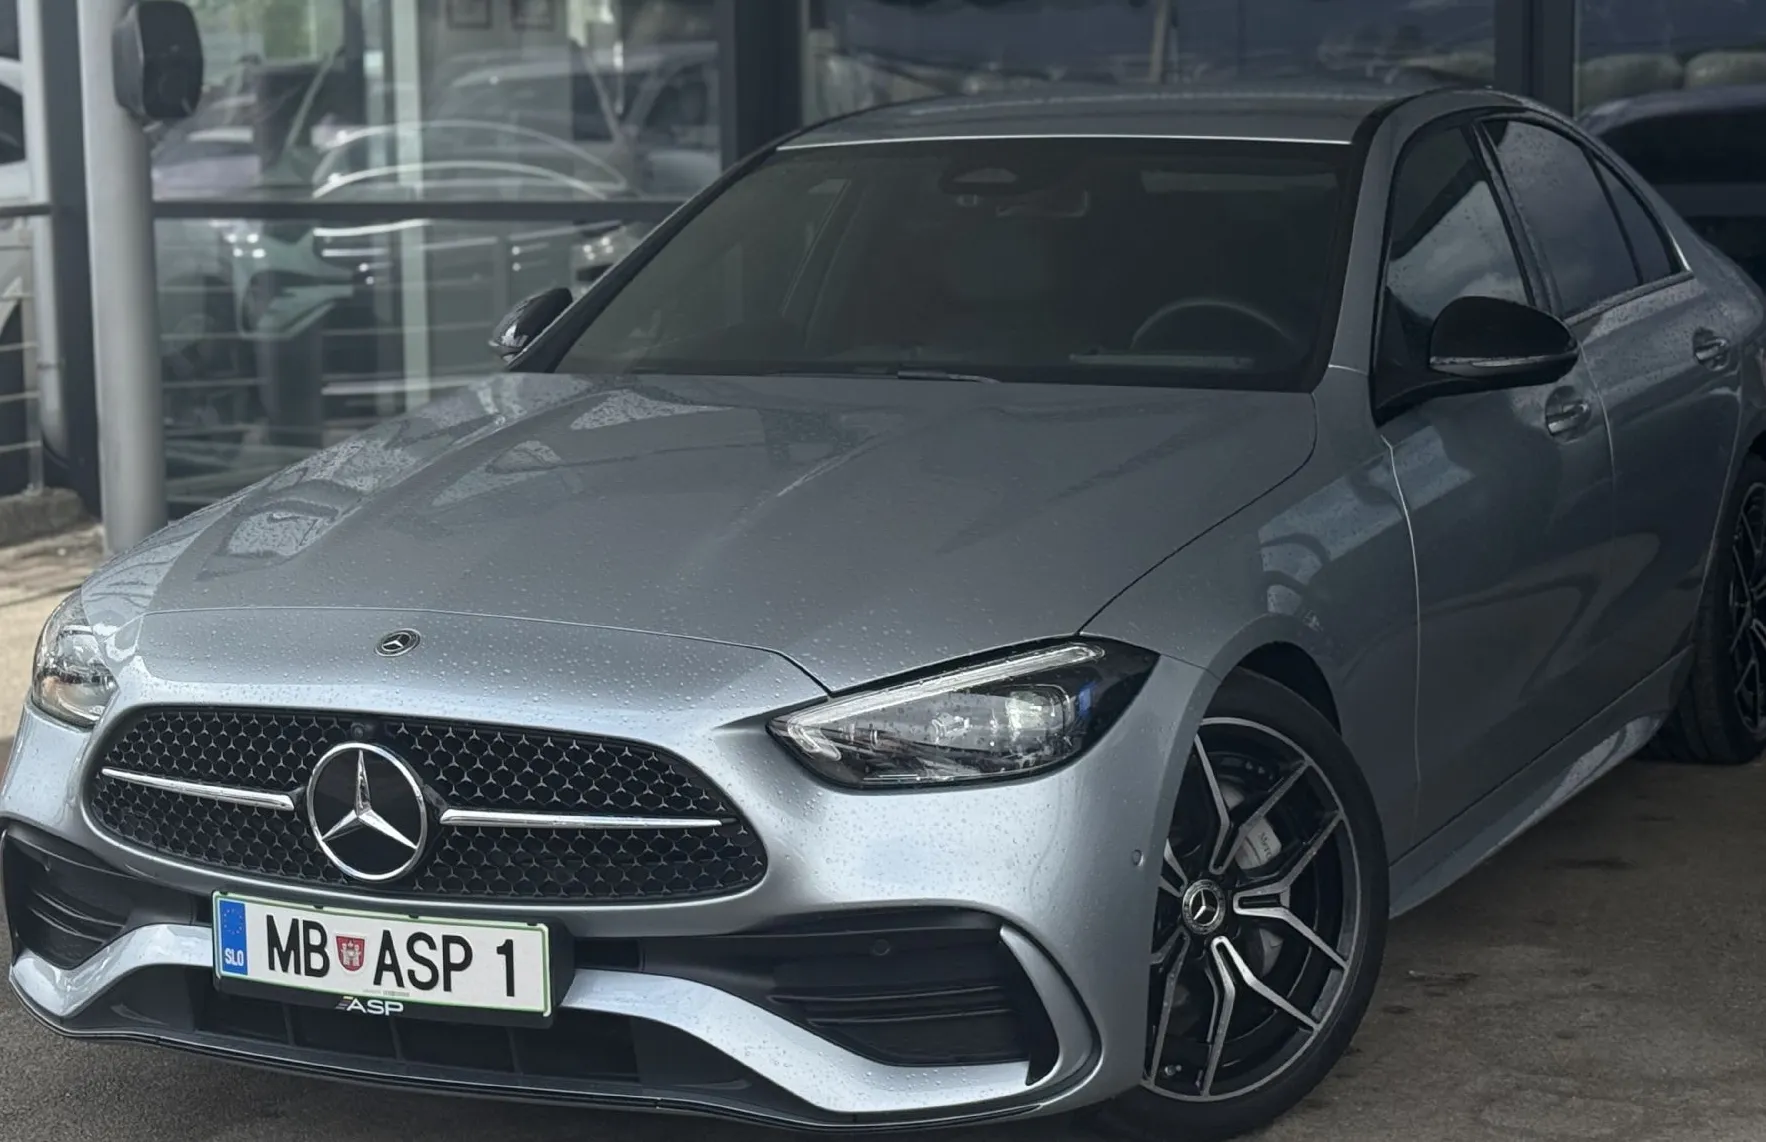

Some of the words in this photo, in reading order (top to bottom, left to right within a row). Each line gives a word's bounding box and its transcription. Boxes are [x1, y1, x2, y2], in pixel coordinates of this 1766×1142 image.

[225, 948, 244, 967] SLO
[266, 914, 330, 978] MB
[373, 929, 473, 992] ASP
[496, 939, 515, 997] 1
[346, 998, 404, 1016] ASP
